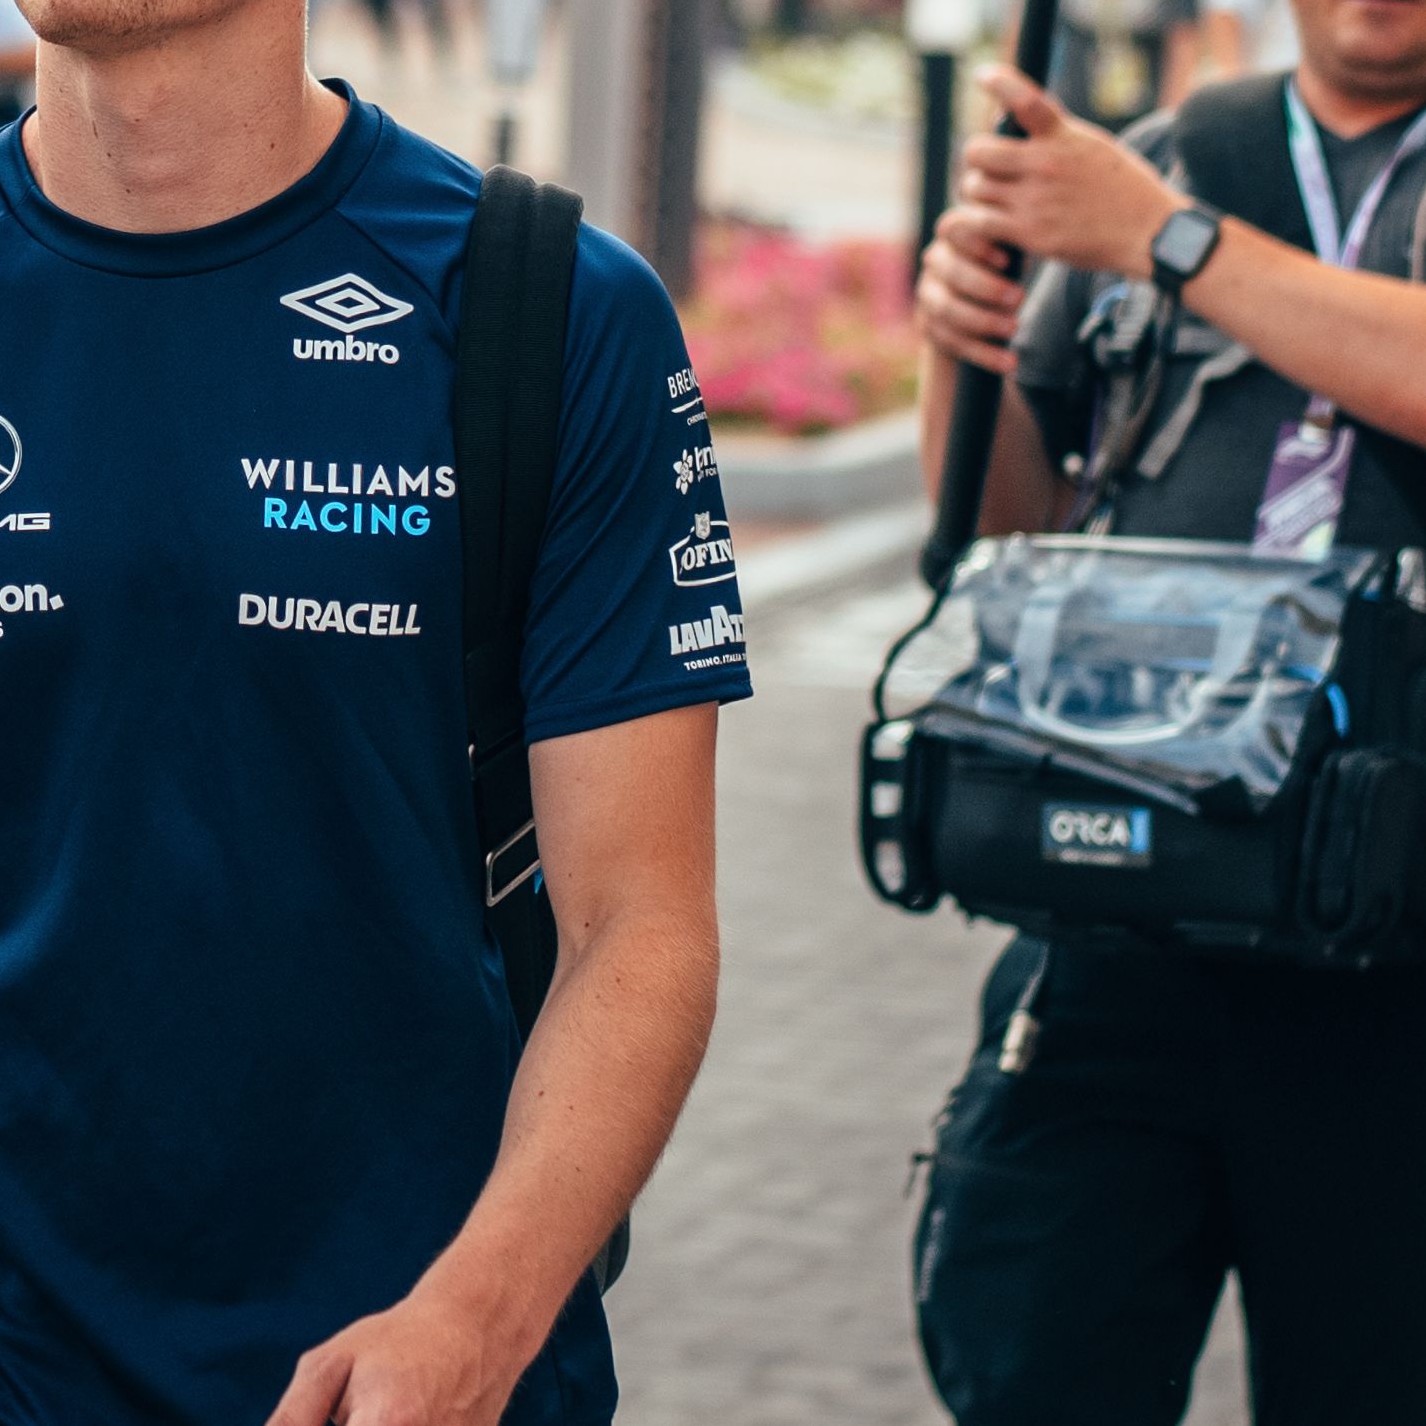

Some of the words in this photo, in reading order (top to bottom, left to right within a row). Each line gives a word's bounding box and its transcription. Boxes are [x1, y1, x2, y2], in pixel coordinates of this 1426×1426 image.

[293, 335, 400, 364] umbro
[241, 458, 456, 498] WILLIAMS
[264, 497, 431, 536] RACING
[238, 593, 421, 636] DURACELL
[1049, 810, 1131, 847] ORCA
